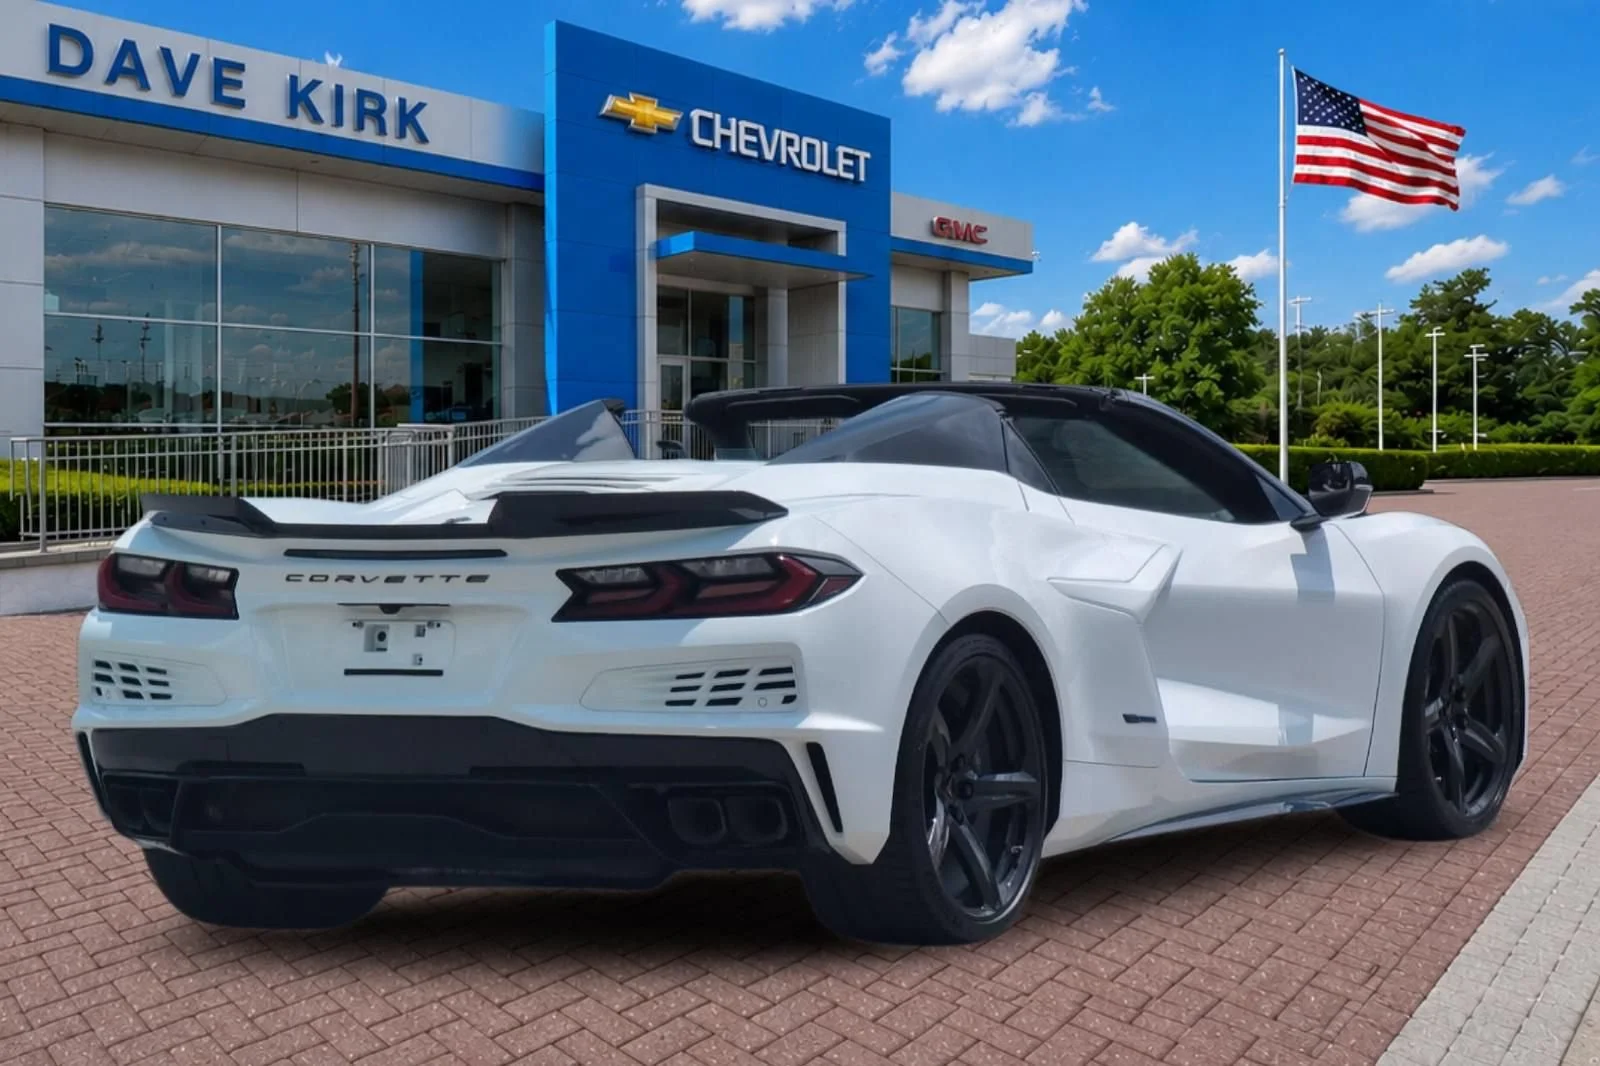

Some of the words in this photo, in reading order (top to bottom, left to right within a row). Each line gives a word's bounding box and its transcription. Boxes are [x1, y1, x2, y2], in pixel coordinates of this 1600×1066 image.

[46, 23, 246, 109] DAVE
[287, 74, 430, 144] KIRK
[690, 108, 871, 182] CHEVROLET
[932, 216, 989, 245] GMC
[285, 573, 491, 584] CORVETTE
